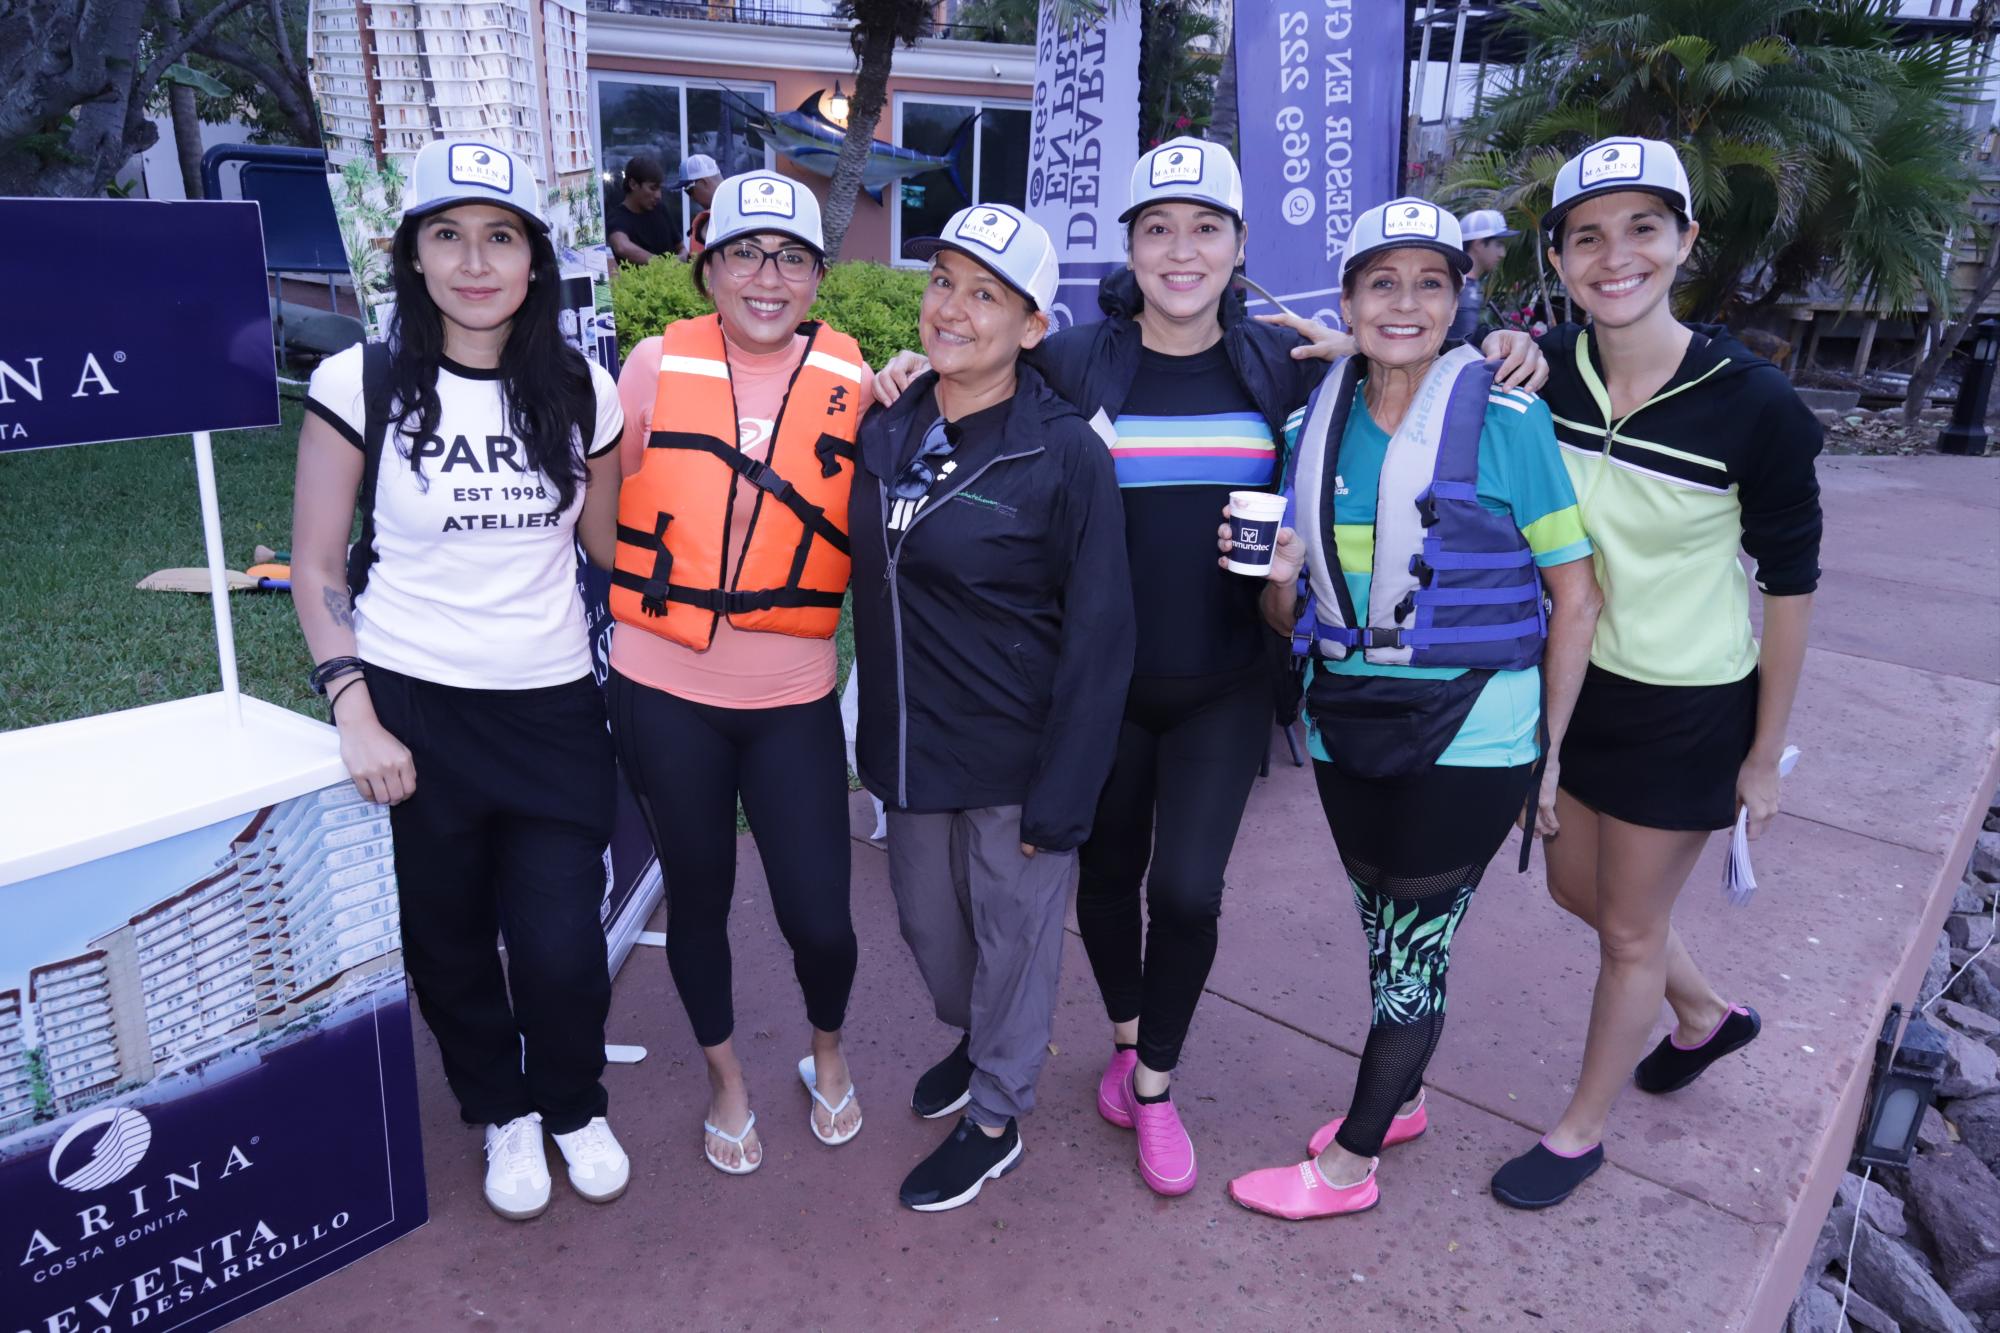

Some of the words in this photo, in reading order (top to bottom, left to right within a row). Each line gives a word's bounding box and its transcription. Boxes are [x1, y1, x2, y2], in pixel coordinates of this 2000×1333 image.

[455, 165, 508, 183] MARINA
[1154, 167, 1199, 178] MARINA
[1584, 162, 1638, 178] MARINA
[744, 196, 791, 209] MARINA
[1387, 220, 1435, 230] MARINA
[411, 434, 539, 473] PAR
[453, 487, 493, 502] EST
[501, 486, 547, 501] 1998
[442, 512, 561, 533] ATELIER
[33, 1245, 105, 1283] COSTA
[114, 1208, 189, 1249] BONITA
[16, 1219, 279, 1333] EVENTA
[131, 1211, 350, 1328] DESARROLLO
